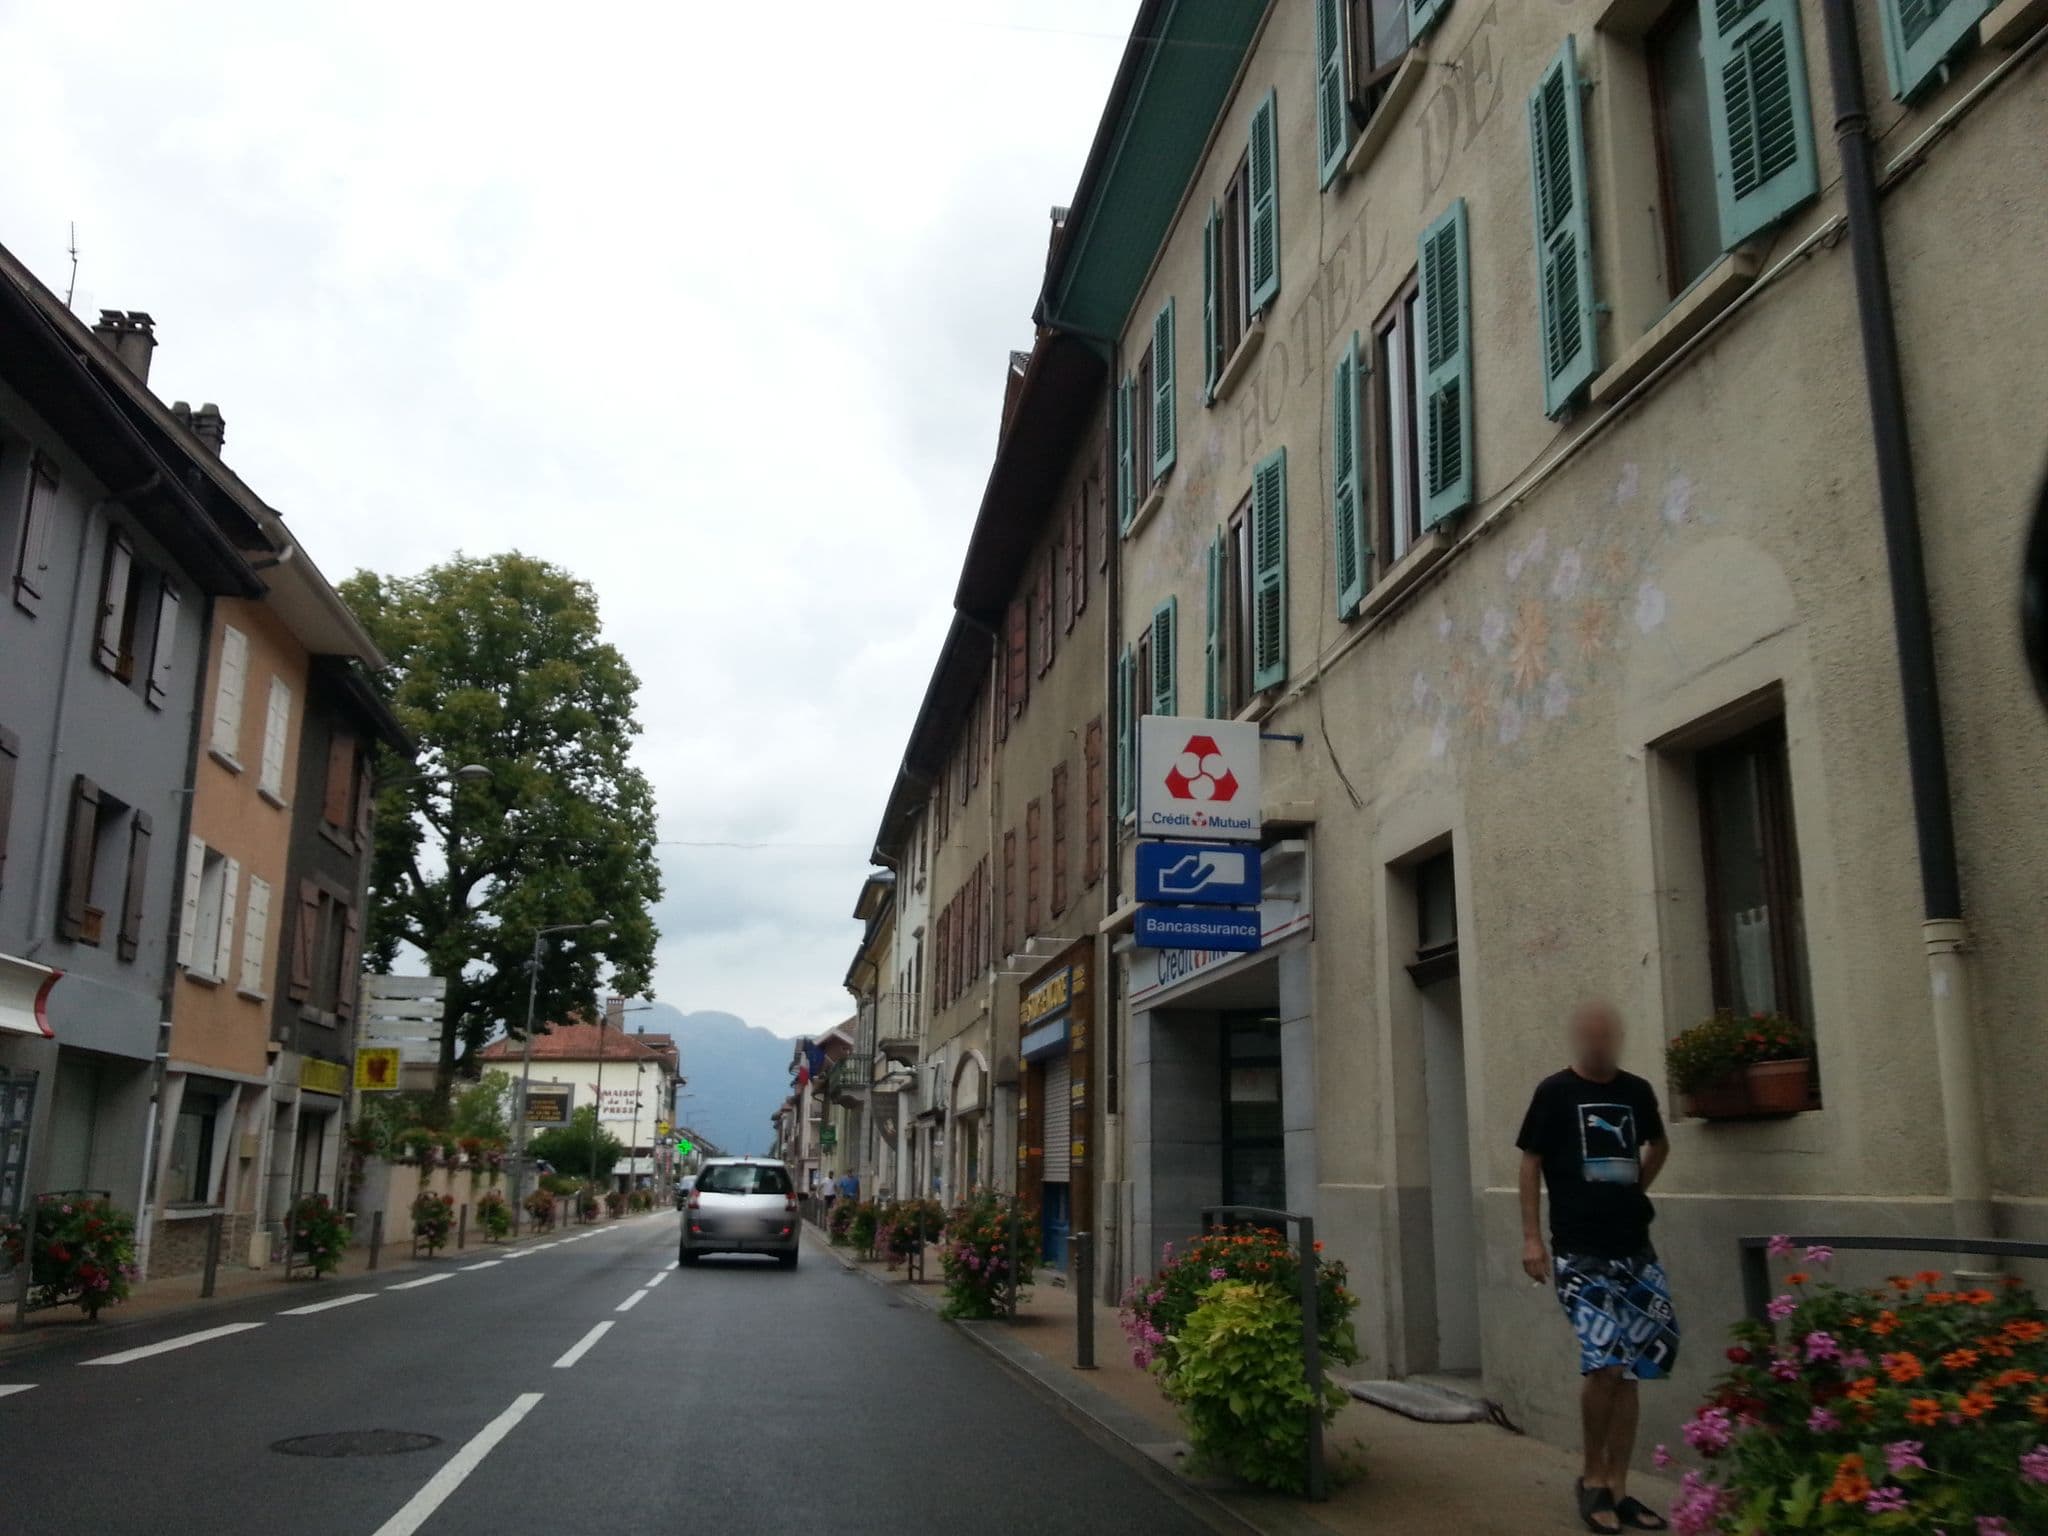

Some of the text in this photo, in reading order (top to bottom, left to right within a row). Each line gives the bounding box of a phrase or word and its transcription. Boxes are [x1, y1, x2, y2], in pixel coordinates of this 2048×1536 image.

[1151, 812, 1251, 829] Crédit Mutuel
[1146, 917, 1257, 936] Bancassurance
[602, 1089, 643, 1097] MAISON
[602, 1106, 636, 1114] PRESS
